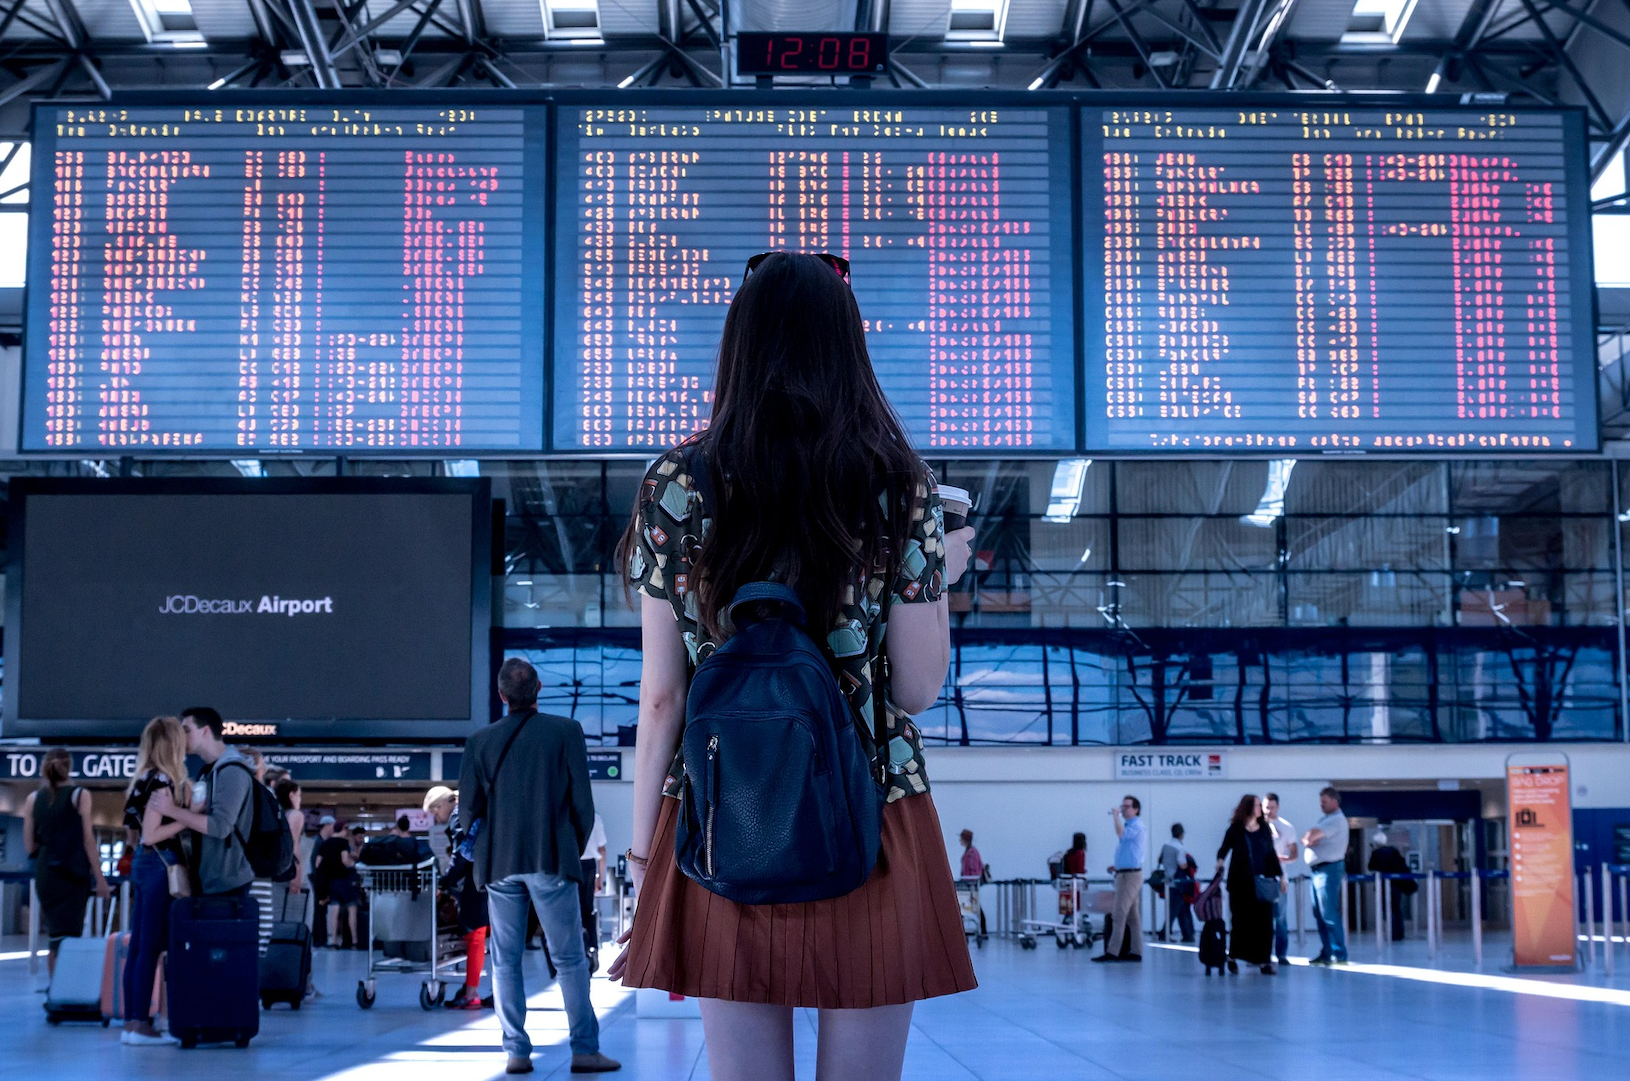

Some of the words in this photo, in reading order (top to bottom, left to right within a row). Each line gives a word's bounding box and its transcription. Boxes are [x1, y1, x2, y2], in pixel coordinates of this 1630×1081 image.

[766, 37, 870, 68] 12:08
[158, 594, 253, 614] JCDecaux
[256, 595, 333, 617] Airport
[6, 754, 37, 777] TO
[271, 755, 288, 763] YOUR
[289, 755, 322, 763] PASSPORT
[323, 755, 337, 763] AND
[337, 755, 371, 763] BOARDING
[371, 755, 388, 763] PASS
[388, 755, 410, 763] READY
[1121, 755, 1153, 767] FAST
[1157, 755, 1202, 767] TRACK
